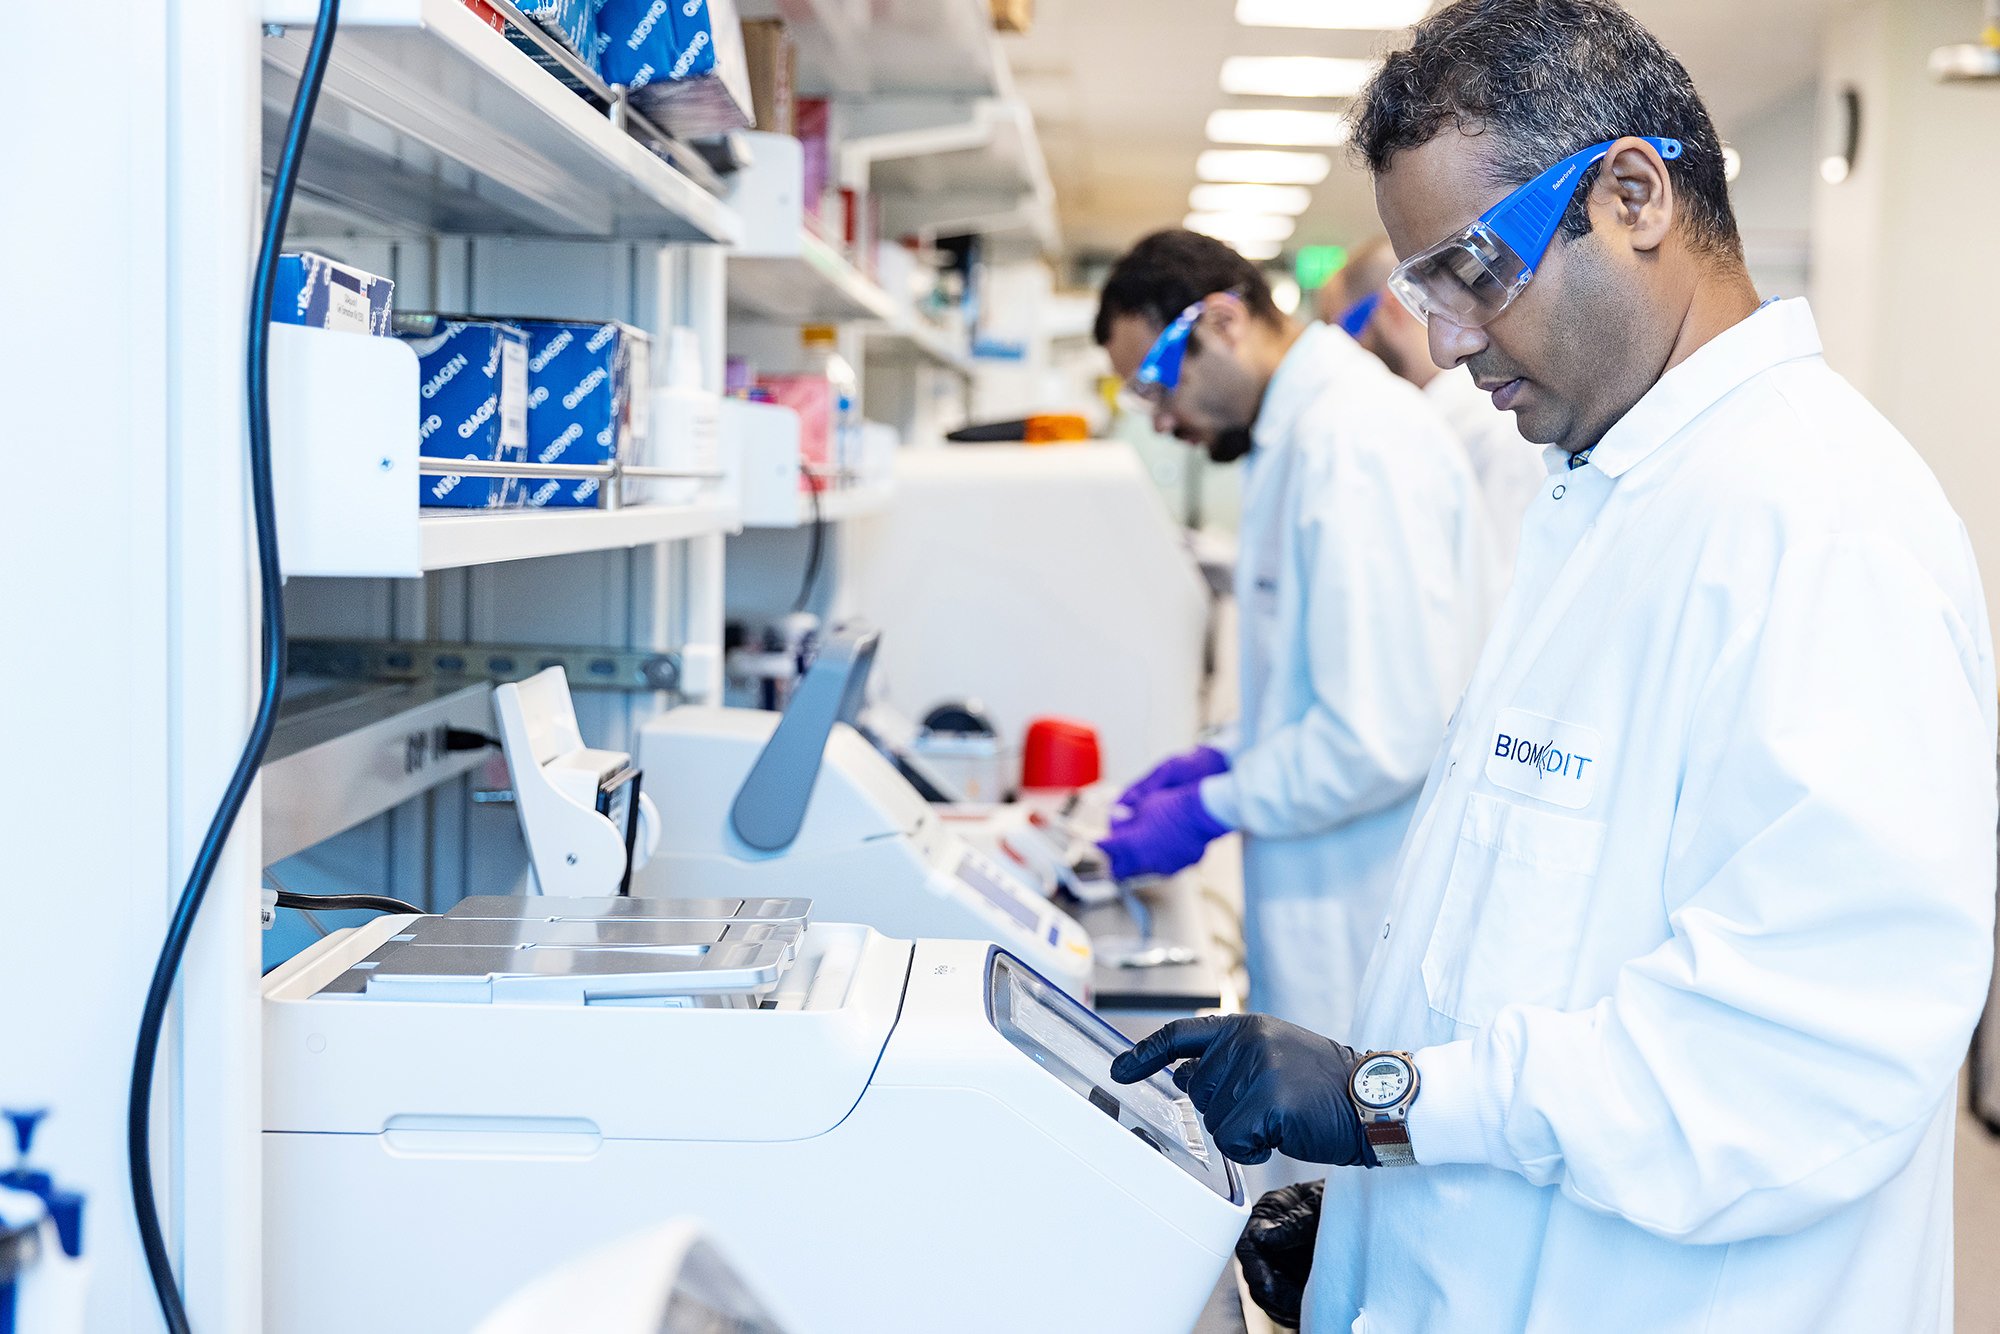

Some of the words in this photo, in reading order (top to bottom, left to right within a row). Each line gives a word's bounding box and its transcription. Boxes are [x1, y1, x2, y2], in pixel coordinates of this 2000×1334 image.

[1552, 163, 1577, 190] fisherbrand
[529, 329, 574, 373] QIAGEN
[422, 353, 468, 399] QIAGEN
[562, 366, 608, 409] QIAGEN
